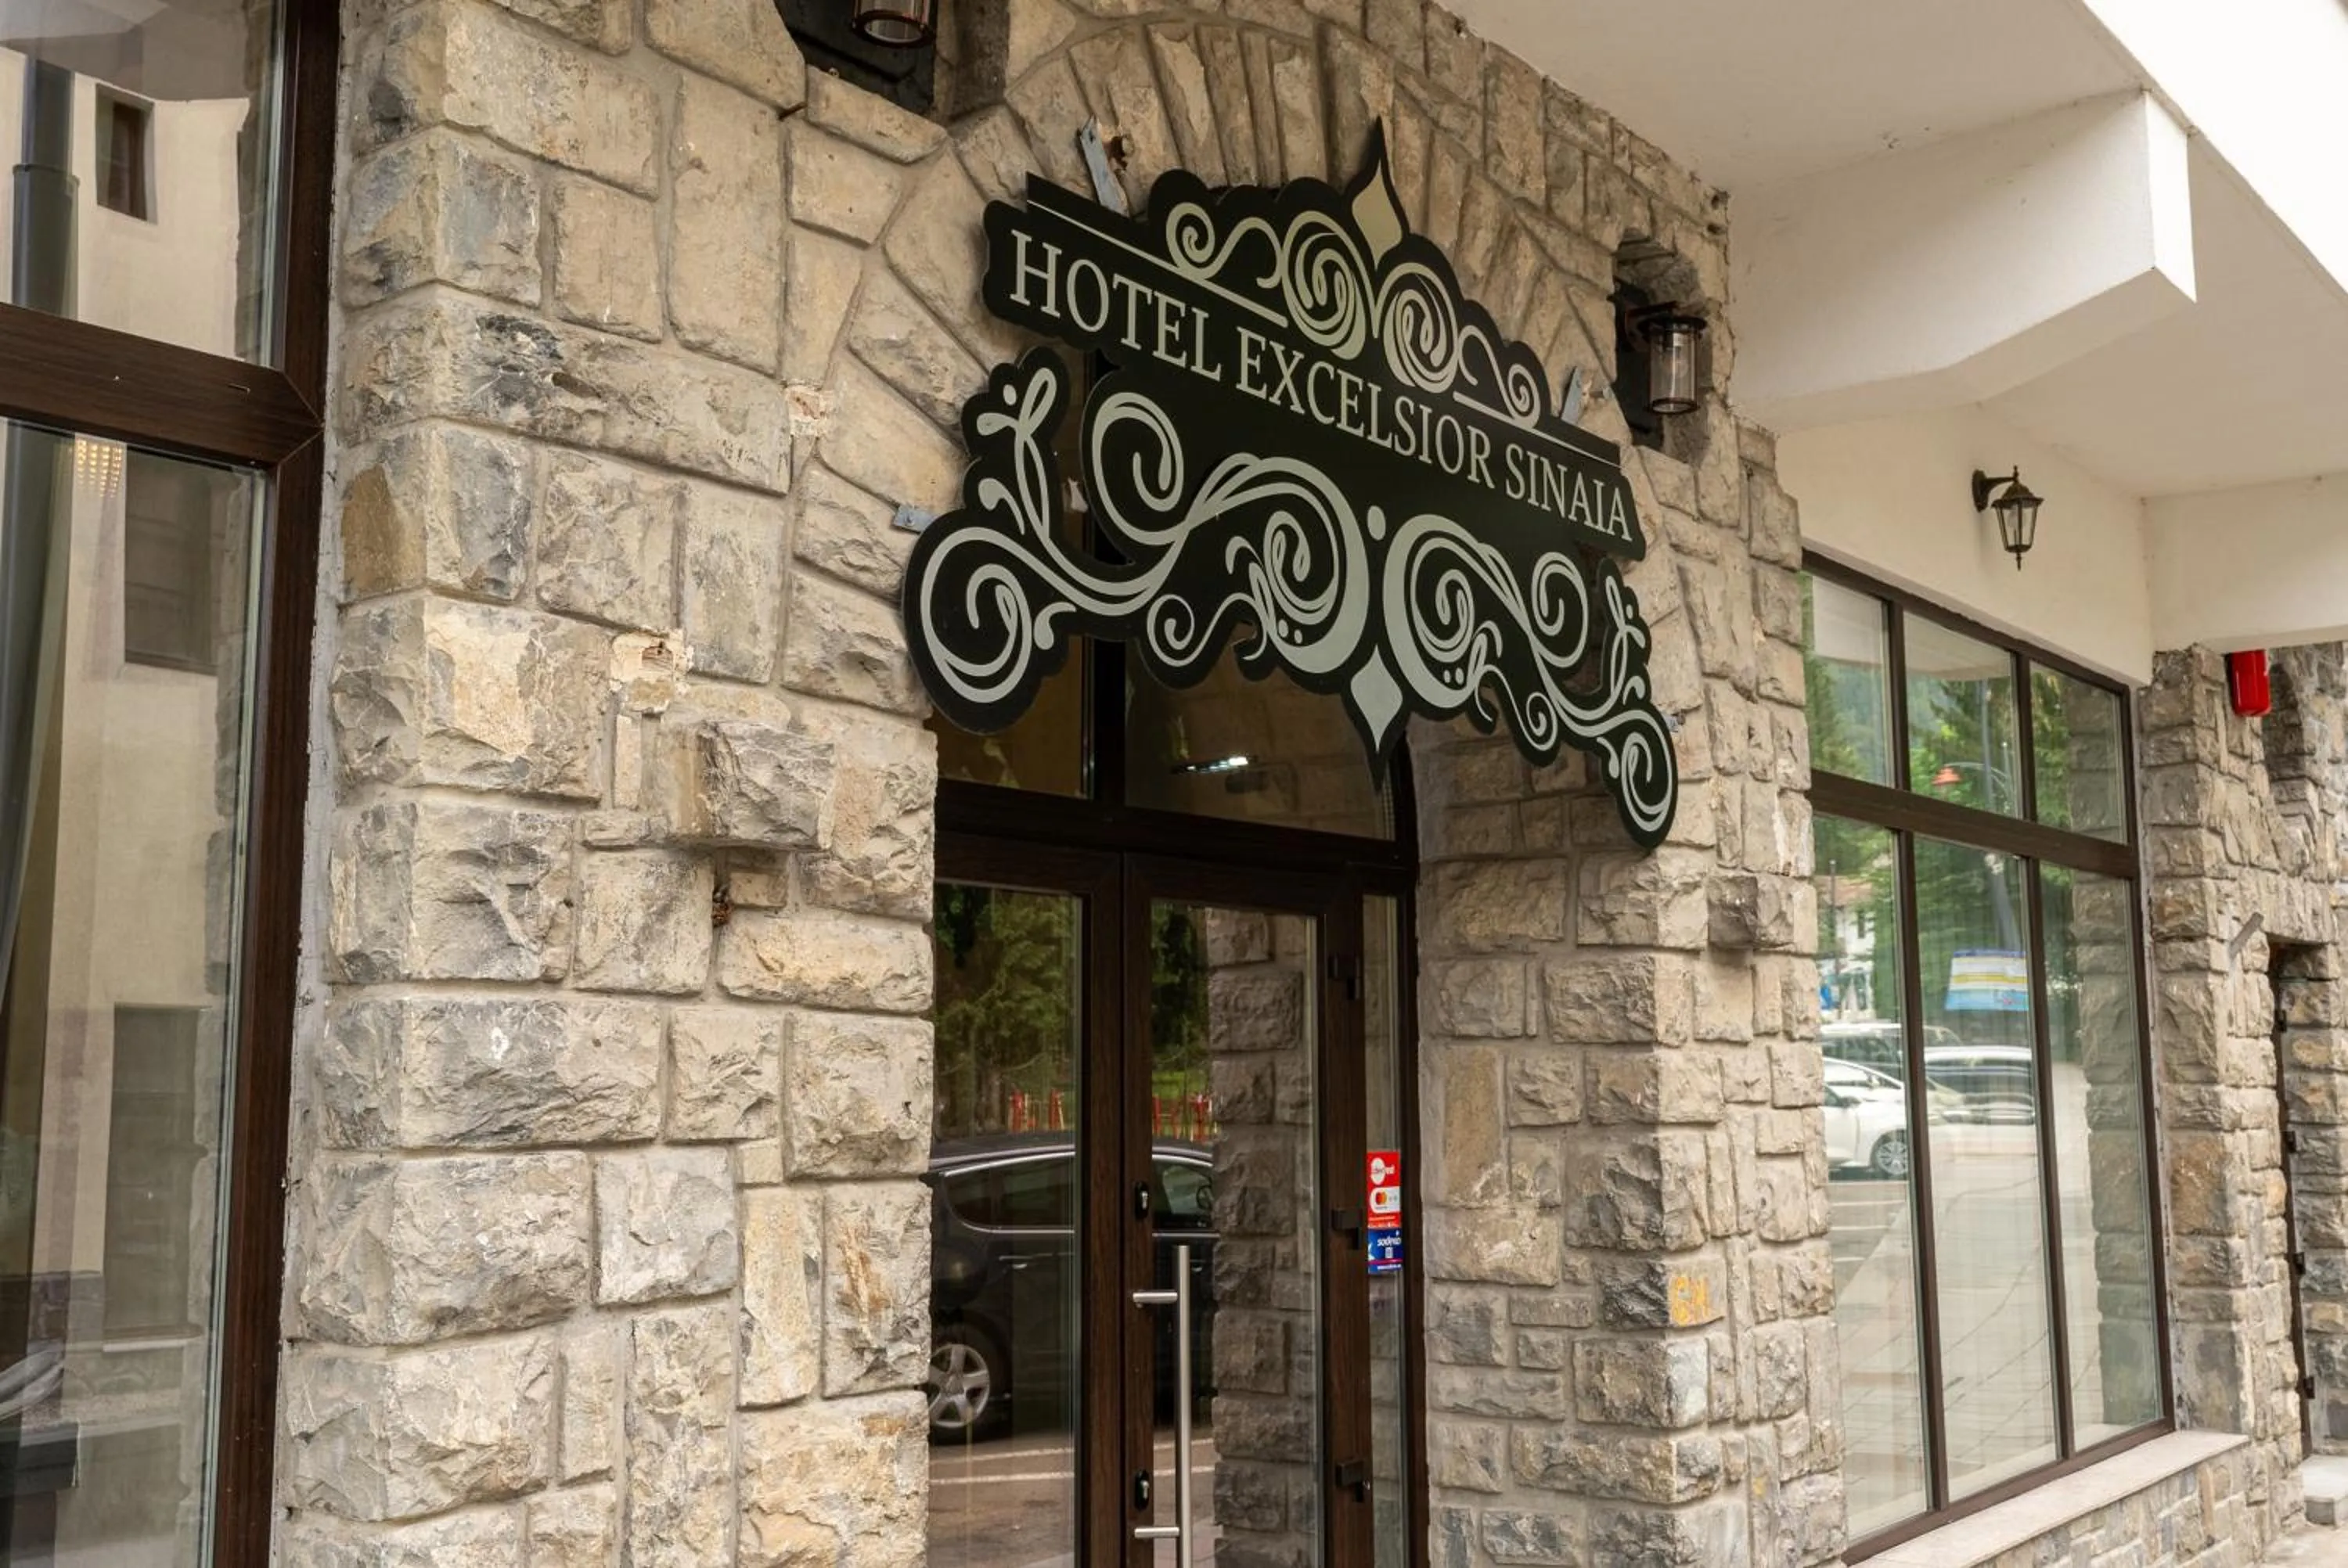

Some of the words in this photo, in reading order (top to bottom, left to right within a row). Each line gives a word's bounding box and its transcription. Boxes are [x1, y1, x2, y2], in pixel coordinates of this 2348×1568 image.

[1010, 229, 1222, 382] HOTEL
[1236, 326, 1495, 490] EXCELSIOR
[1506, 443, 1633, 541] SINAIA
